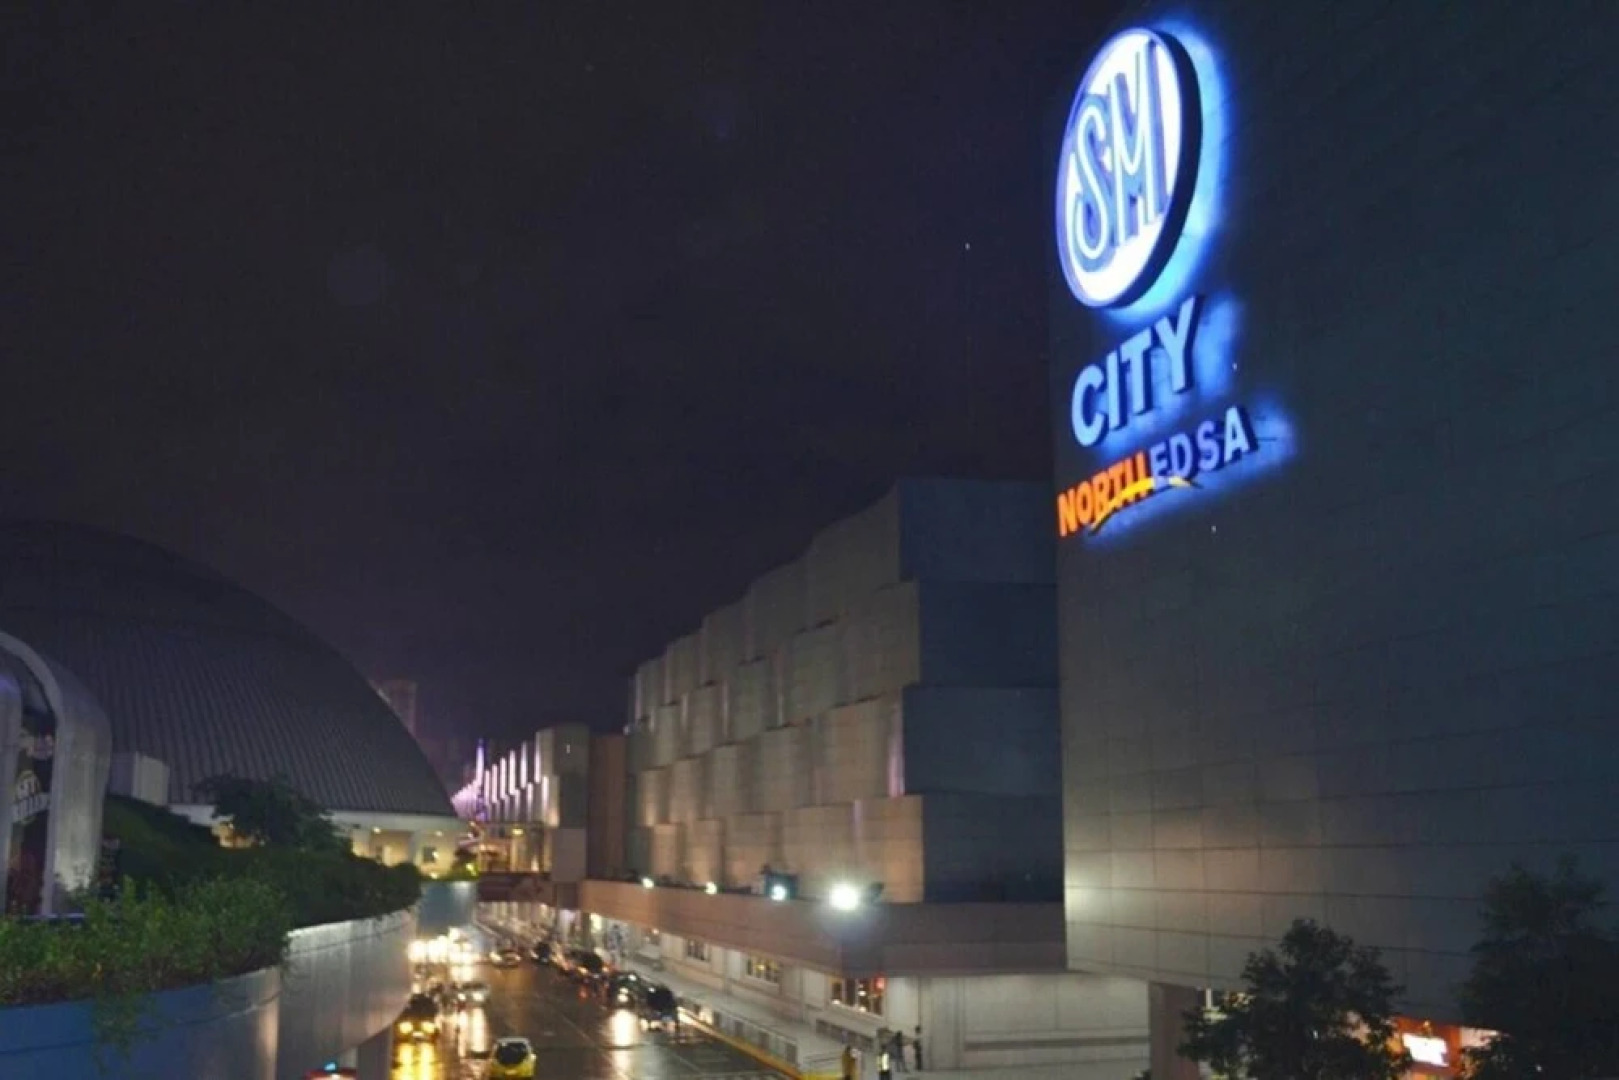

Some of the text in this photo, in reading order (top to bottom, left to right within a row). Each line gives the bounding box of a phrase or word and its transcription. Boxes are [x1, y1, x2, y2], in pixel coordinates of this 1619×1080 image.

[1071, 38, 1168, 274] SM
[1072, 296, 1197, 447] CITY
[1057, 405, 1252, 538] NORTH EDSA
